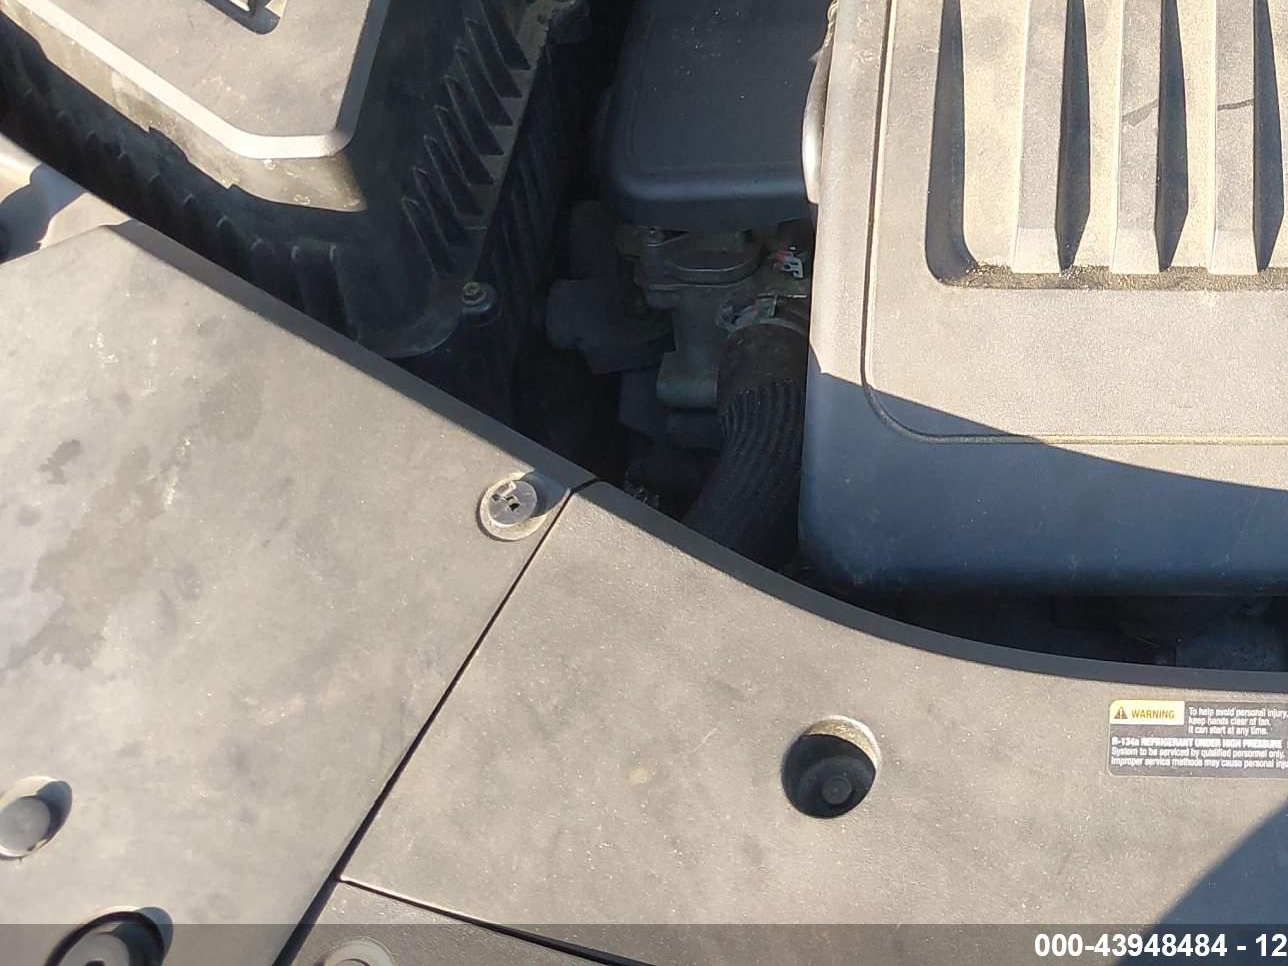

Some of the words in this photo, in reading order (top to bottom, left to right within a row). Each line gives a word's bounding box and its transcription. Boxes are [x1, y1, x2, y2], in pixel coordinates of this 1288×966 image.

[1131, 709, 1175, 719] WARNING
[1188, 706, 1197, 715] To
[1199, 707, 1214, 717] help
[1216, 708, 1235, 716] avoid
[1236, 708, 1265, 718] personal
[1188, 717, 1205, 726] keep
[1208, 717, 1228, 725] hands
[1249, 718, 1257, 726] of
[1209, 726, 1226, 734] start
[1236, 727, 1249, 736] any
[1112, 737, 1140, 746] R-134a
[1141, 737, 1193, 746] REFRIGERANT
[1195, 738, 1221, 747] UNDER
[1222, 738, 1241, 748] HIGH
[1243, 739, 1283, 749] PRESSURE
[1112, 747, 1138, 756] System
[1140, 748, 1147, 756] to
[1149, 748, 1157, 756] be
[1160, 748, 1189, 756] serviced
[1191, 748, 1199, 757] by
[1201, 749, 1231, 758] qualified
[1233, 750, 1267, 759] personnel
[1111, 756, 1144, 766] Improper
[1145, 757, 1170, 765] service
[1172, 758, 1202, 766] methods
[1204, 760, 1219, 768] may
[1244, 760, 1274, 768] personal
